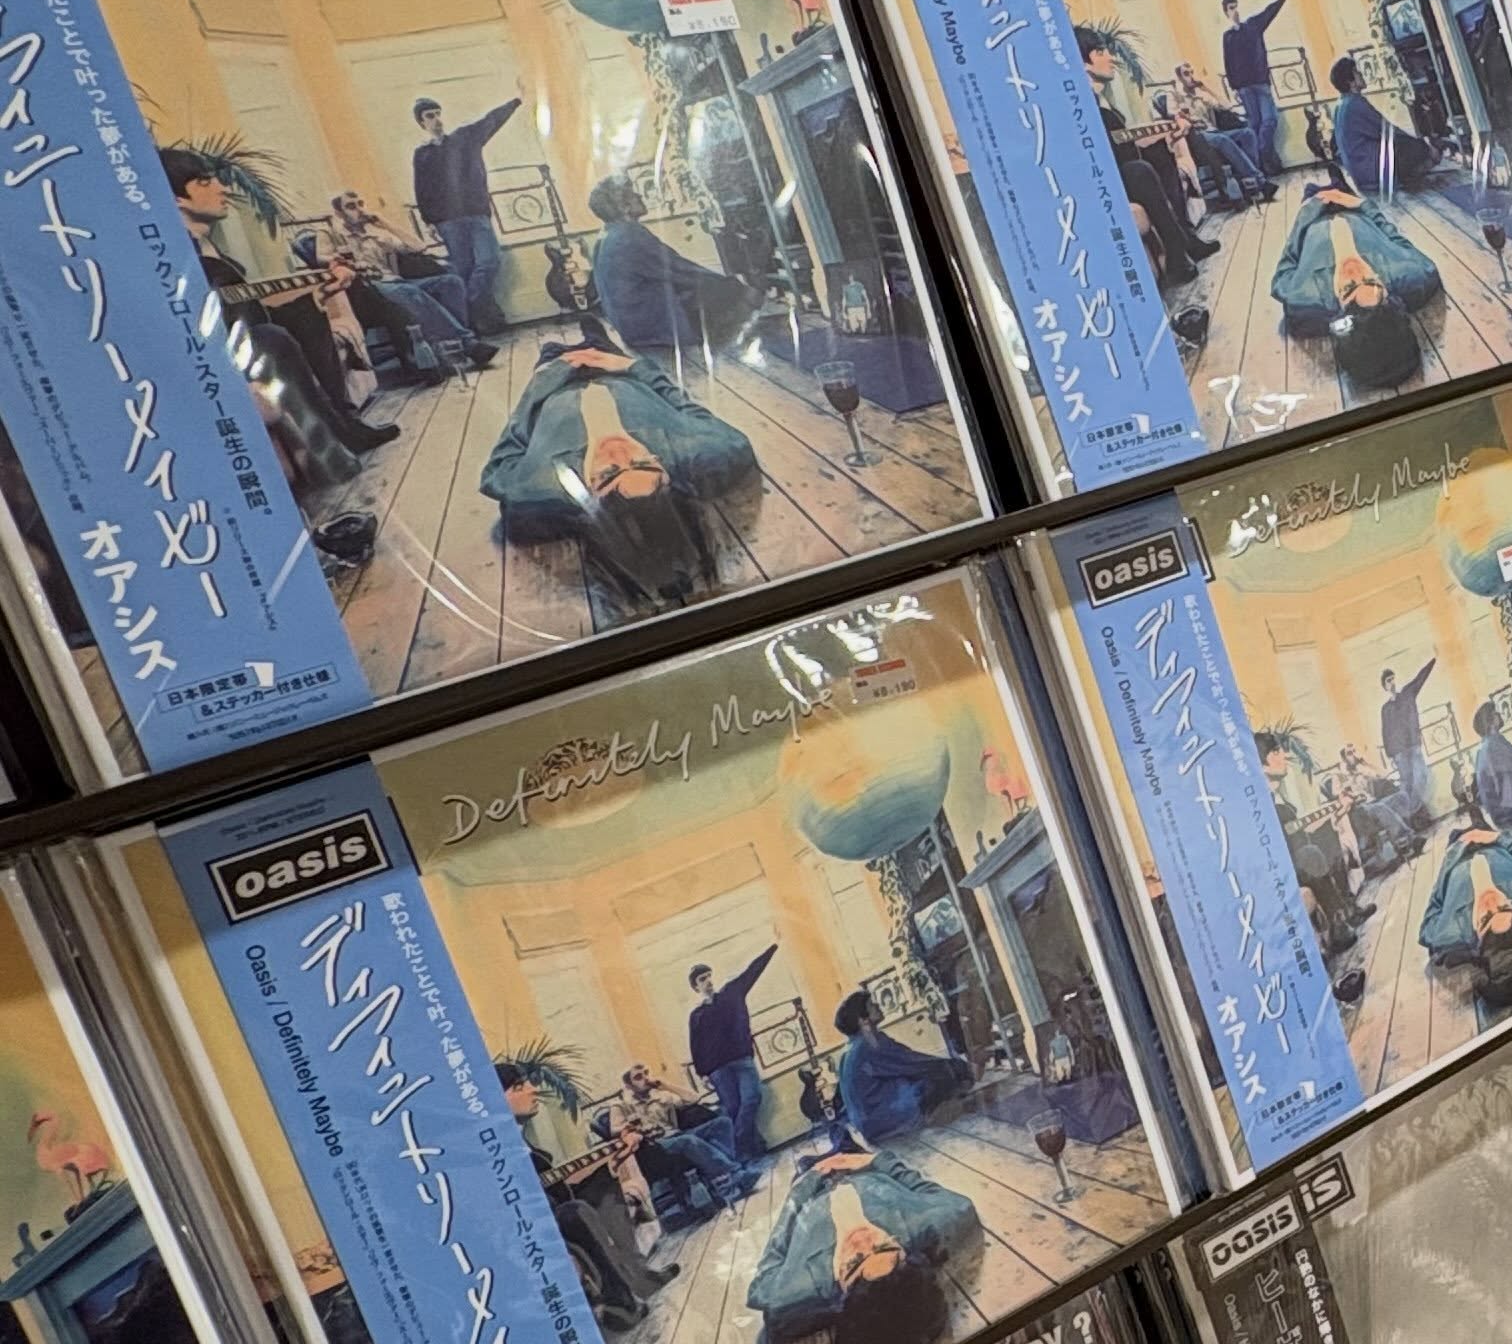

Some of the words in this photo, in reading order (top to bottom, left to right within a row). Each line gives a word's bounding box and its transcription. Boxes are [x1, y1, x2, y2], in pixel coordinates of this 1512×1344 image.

[940, 10, 966, 66] Maybe
[1033, 299, 1093, 422] オアシス
[1393, 442, 1471, 499] Maybe
[80, 519, 178, 680] オアシス
[1094, 546, 1175, 591] oasis
[165, 670, 250, 708] 日本限定帯
[1101, 625, 1121, 669] Oasis
[1118, 679, 1146, 746] Definitely
[1140, 746, 1163, 796] Maybe
[442, 719, 693, 846] Definitely
[234, 835, 368, 899] oasis
[245, 943, 278, 998] Oasis
[272, 1009, 320, 1099] Definitely
[310, 1094, 345, 1158] Maybe
[1217, 994, 1267, 1105] オアシス
[1210, 1203, 1294, 1267] oasis
[1223, 1292, 1243, 1332] Oasis
